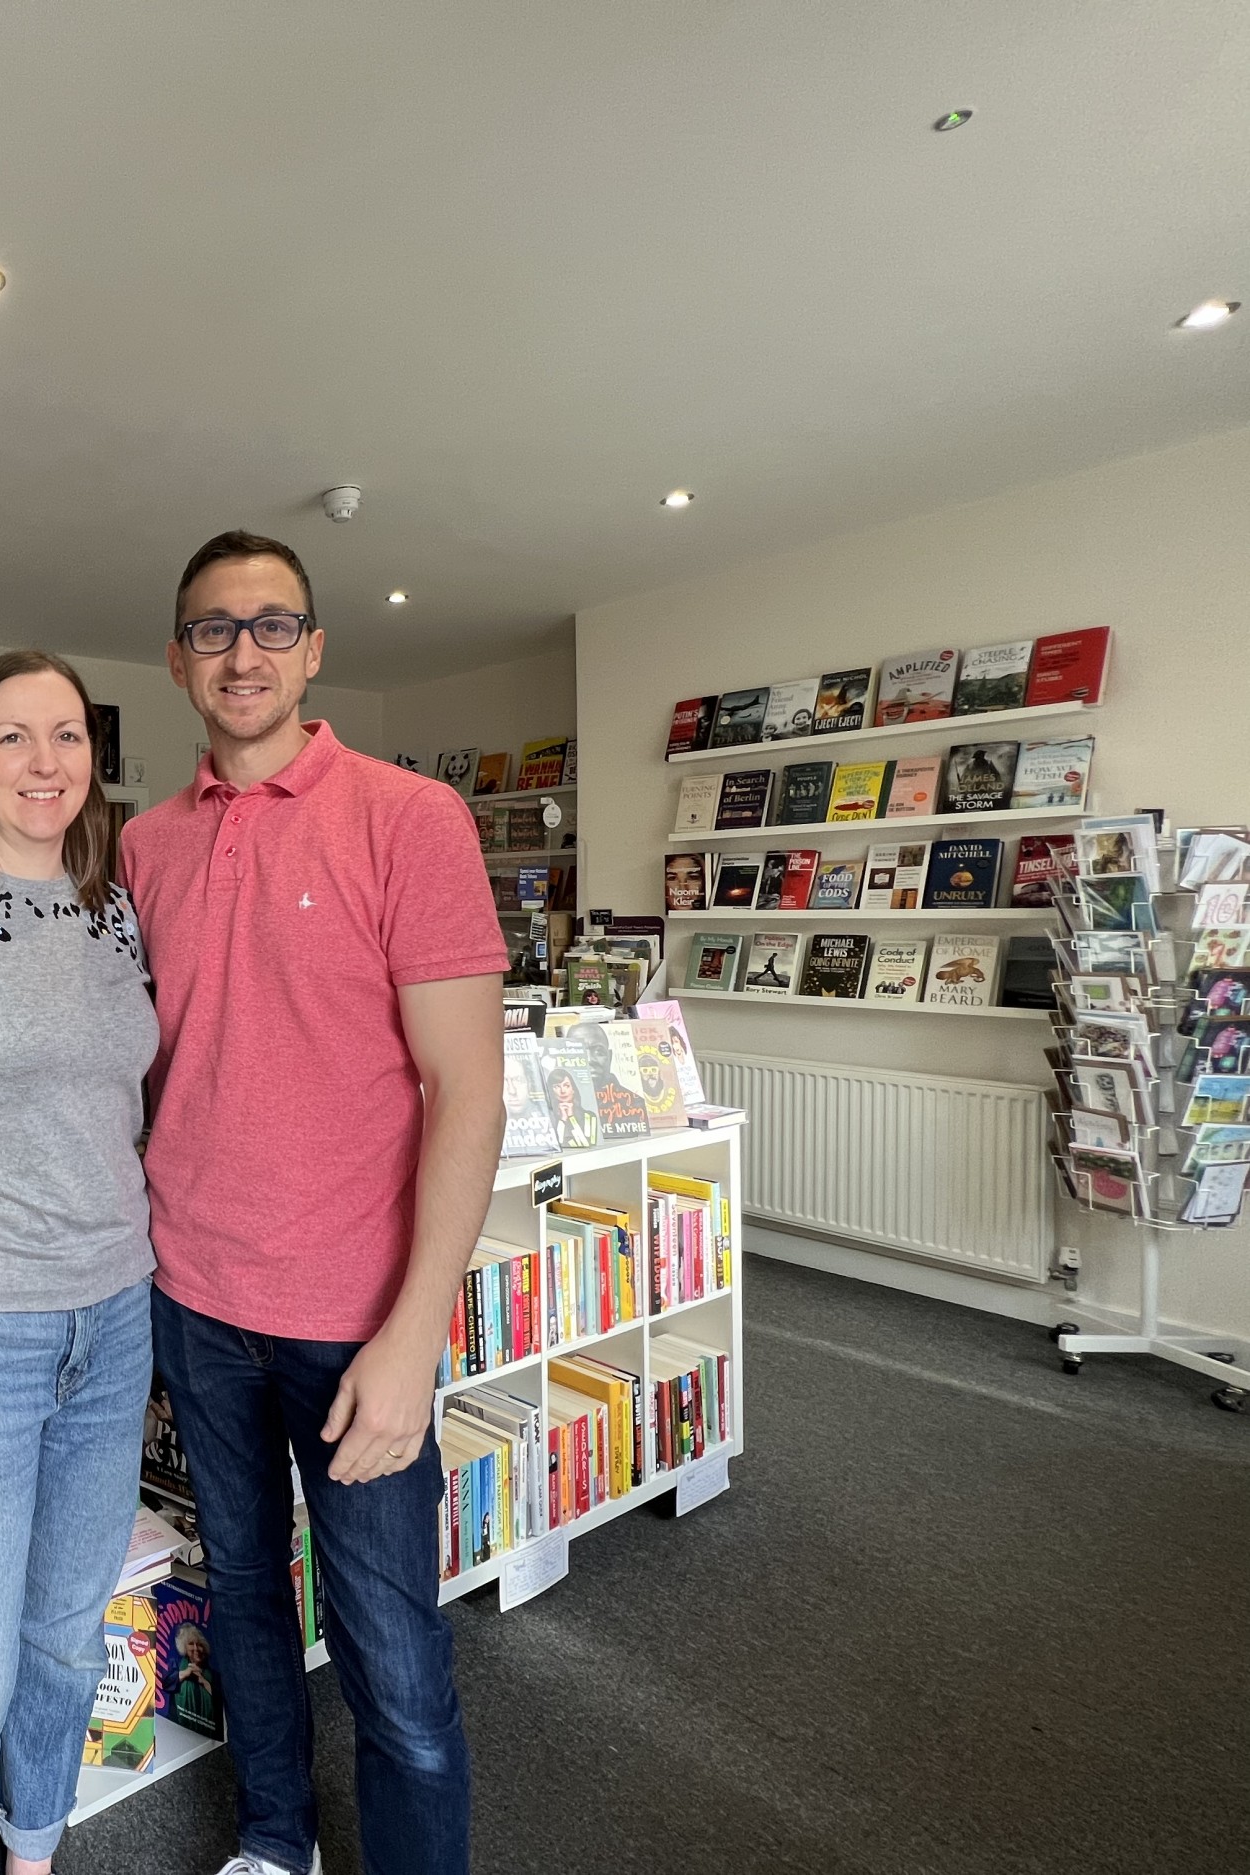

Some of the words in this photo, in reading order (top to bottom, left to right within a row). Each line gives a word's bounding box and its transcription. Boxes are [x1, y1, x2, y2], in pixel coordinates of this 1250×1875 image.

[978, 648, 1013, 659] STEEPLE
[971, 655, 1018, 667] CHASING
[888, 660, 951, 680] AMPLIFIED
[675, 708, 699, 720] PUTIN'S
[815, 719, 837, 730] EJECT!
[838, 714, 861, 727] EJECT!
[524, 760, 562, 777] WANNA
[517, 777, 532, 790] BE
[536, 776, 559, 789] ME
[736, 775, 765, 785] Search
[959, 774, 996, 783] JAMES
[682, 791, 712, 800] POINTS
[723, 794, 733, 803] of
[735, 794, 761, 803] Berlin
[949, 794, 964, 802] THE
[966, 792, 1003, 801] SAVAGE
[955, 800, 994, 810] STORM
[949, 843, 983, 852] DAVID
[938, 850, 992, 859] MITCHELL
[821, 874, 853, 883] FOOD
[669, 887, 700, 897] Naomi
[818, 888, 850, 898] CODS
[933, 890, 986, 901] UNRULY
[820, 938, 855, 948] MICHAEL
[937, 936, 994, 946] EMPEROR
[823, 948, 848, 957] LEWIS
[879, 948, 903, 957] Code
[906, 949, 917, 957] of
[952, 947, 992, 957] ROME
[878, 956, 915, 965] Conduct
[577, 982, 602, 991] Faith
[761, 987, 787, 996] Stewart
[938, 985, 977, 996] MARY
[930, 992, 984, 1007] BEARD
[557, 1056, 588, 1067] Parts
[616, 1121, 647, 1133] MYRIE
[653, 1233, 662, 1295] WIFEDOM
[466, 1275, 475, 1310] ESCAPE
[467, 1315, 477, 1353] GHETTO
[533, 1412, 541, 1446] ROAR
[580, 1421, 588, 1490] SEDARIS
[461, 1469, 471, 1512] ANNA
